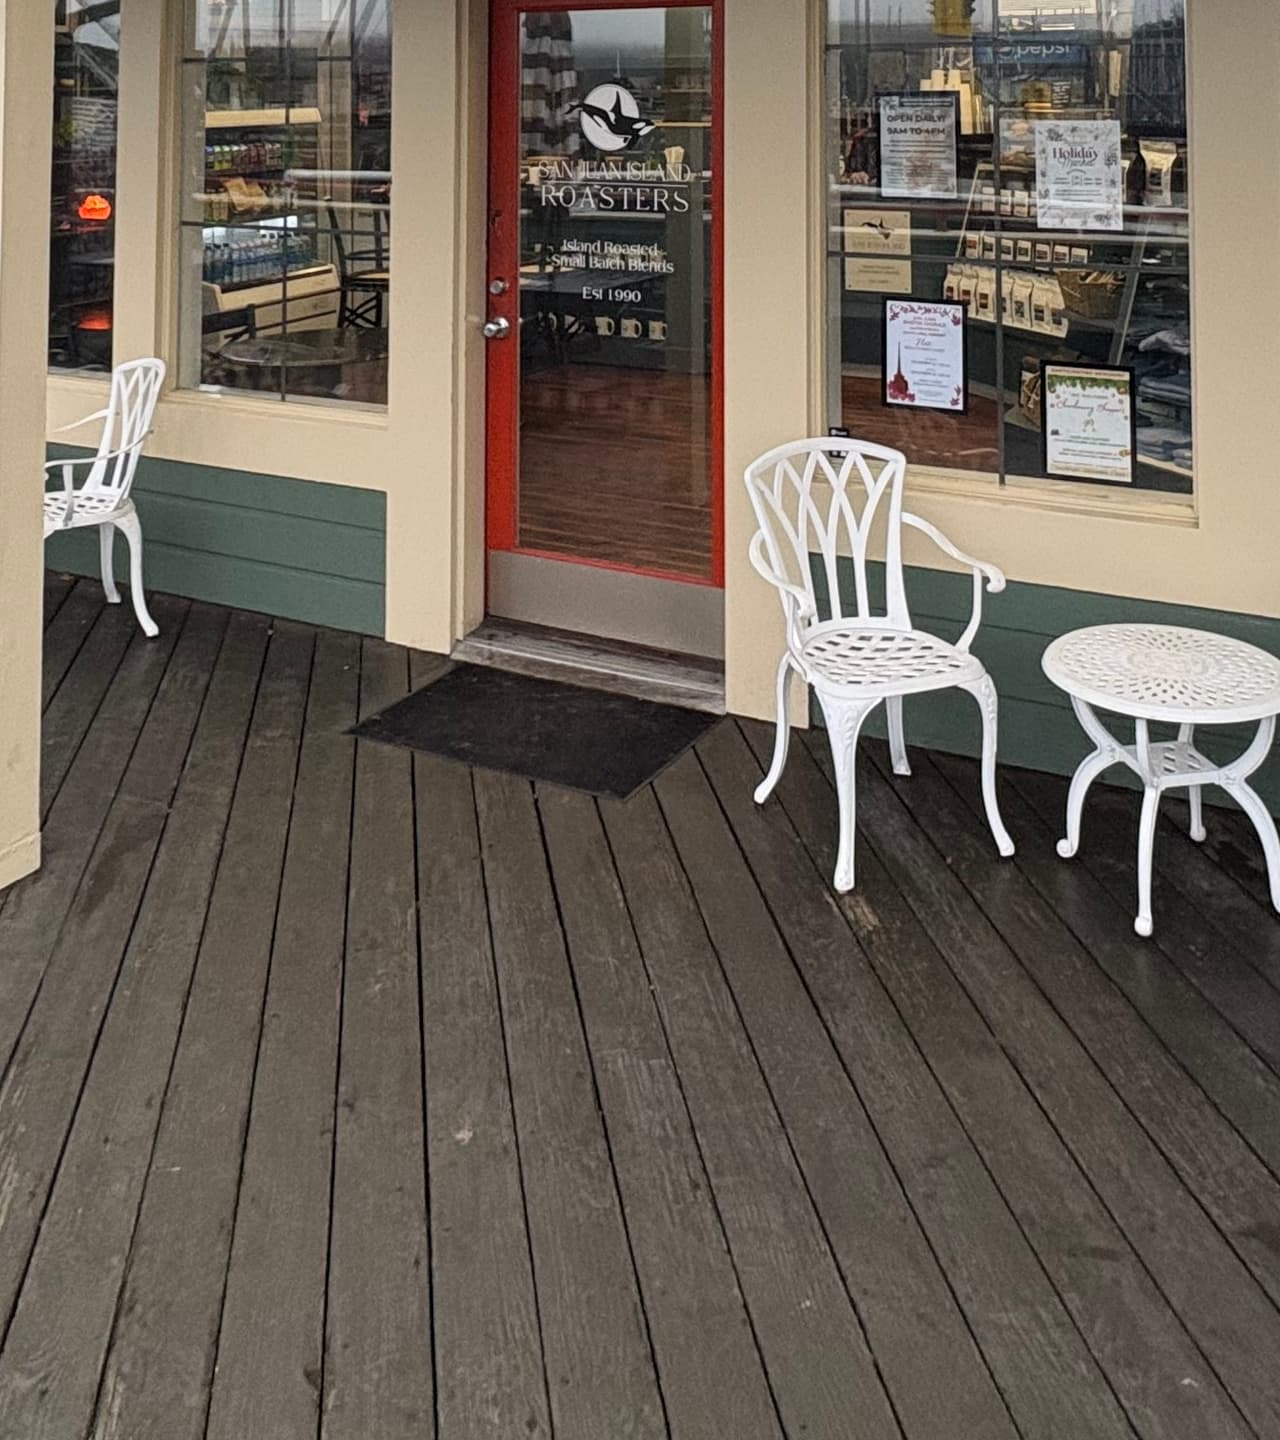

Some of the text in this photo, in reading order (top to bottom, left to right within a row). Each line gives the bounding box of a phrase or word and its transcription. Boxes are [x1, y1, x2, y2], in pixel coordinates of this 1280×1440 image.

[886, 113, 913, 123] OPEN
[1052, 146, 1099, 162] Holiday
[538, 160, 691, 183] SAN JUAN ISLAND
[541, 184, 690, 213] ROASTERS
[562, 239, 658, 257] Island Roasted
[551, 253, 675, 274] Small Batch Blends
[582, 286, 642, 303] Est 1990
